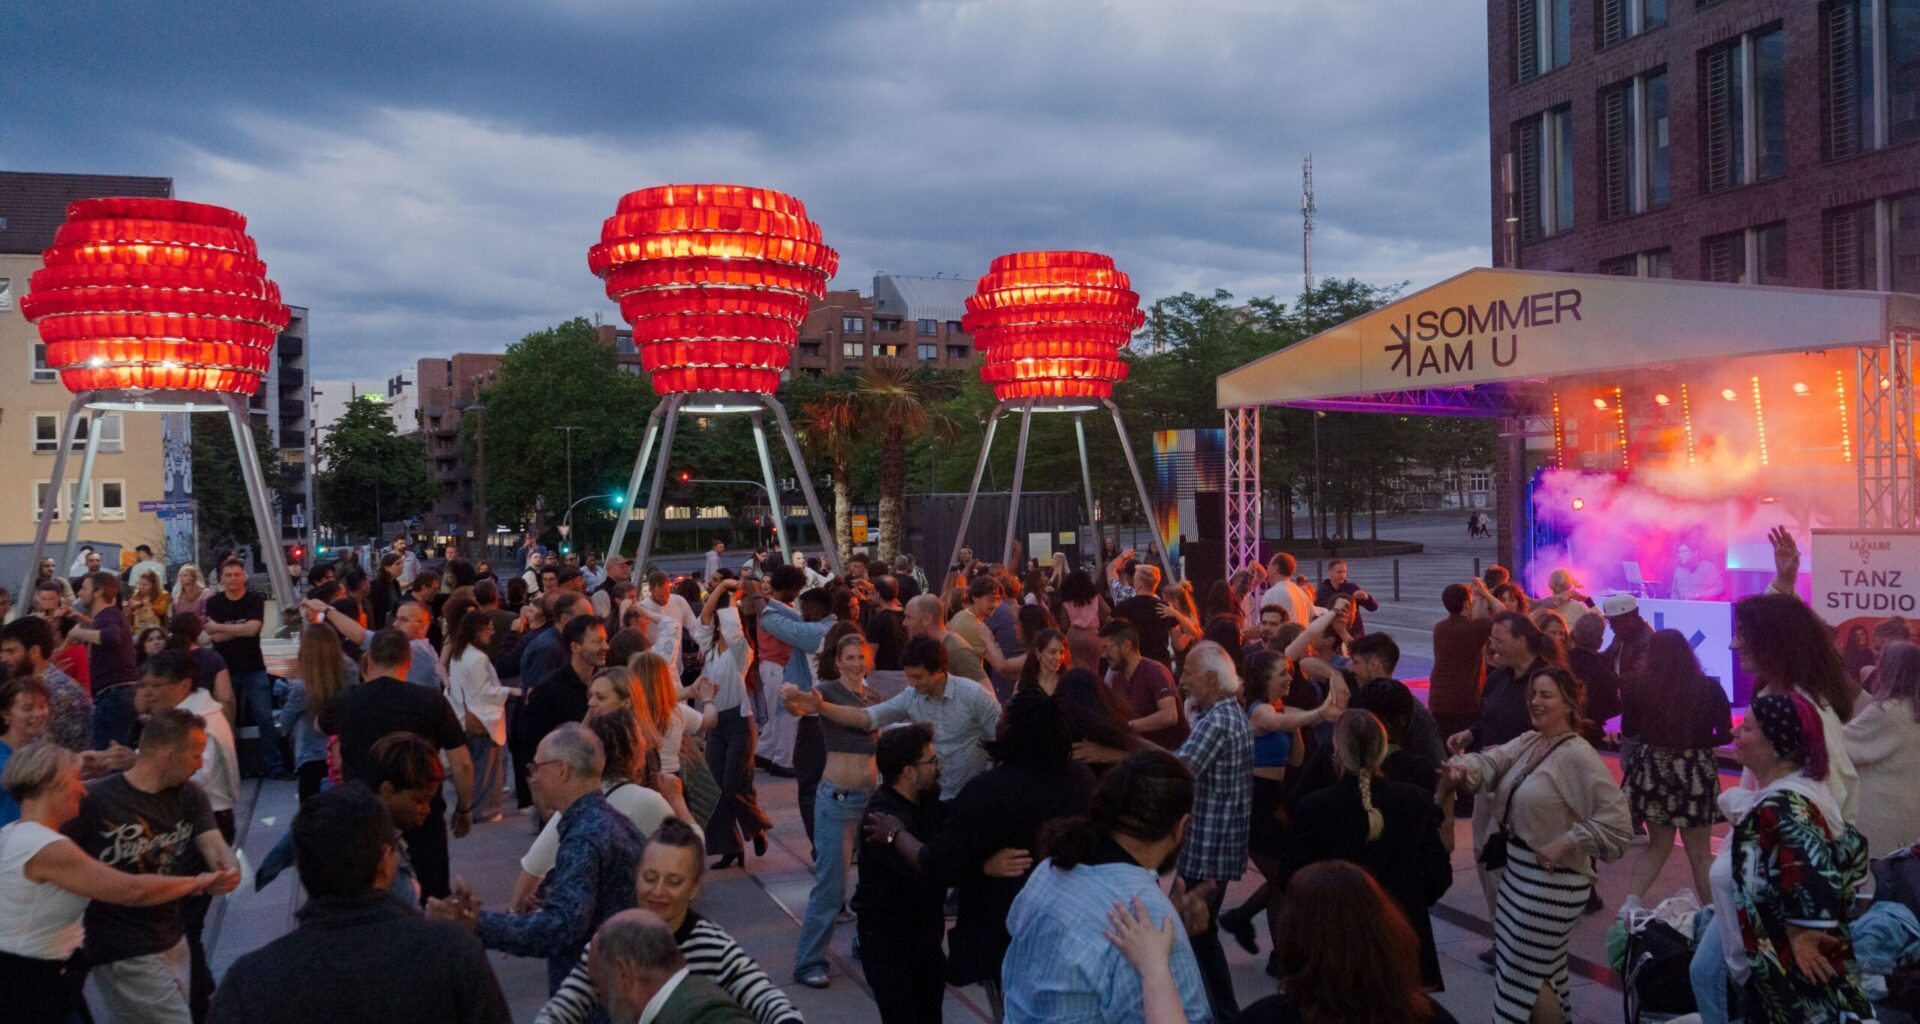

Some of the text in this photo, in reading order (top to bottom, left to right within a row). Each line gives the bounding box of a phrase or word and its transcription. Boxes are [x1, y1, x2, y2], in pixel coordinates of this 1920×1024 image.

[1416, 288, 1582, 341] SOMMER
[1417, 334, 1518, 376] AM U
[1840, 570, 1902, 588] TANZ
[1826, 592, 1916, 611] STUDIO
